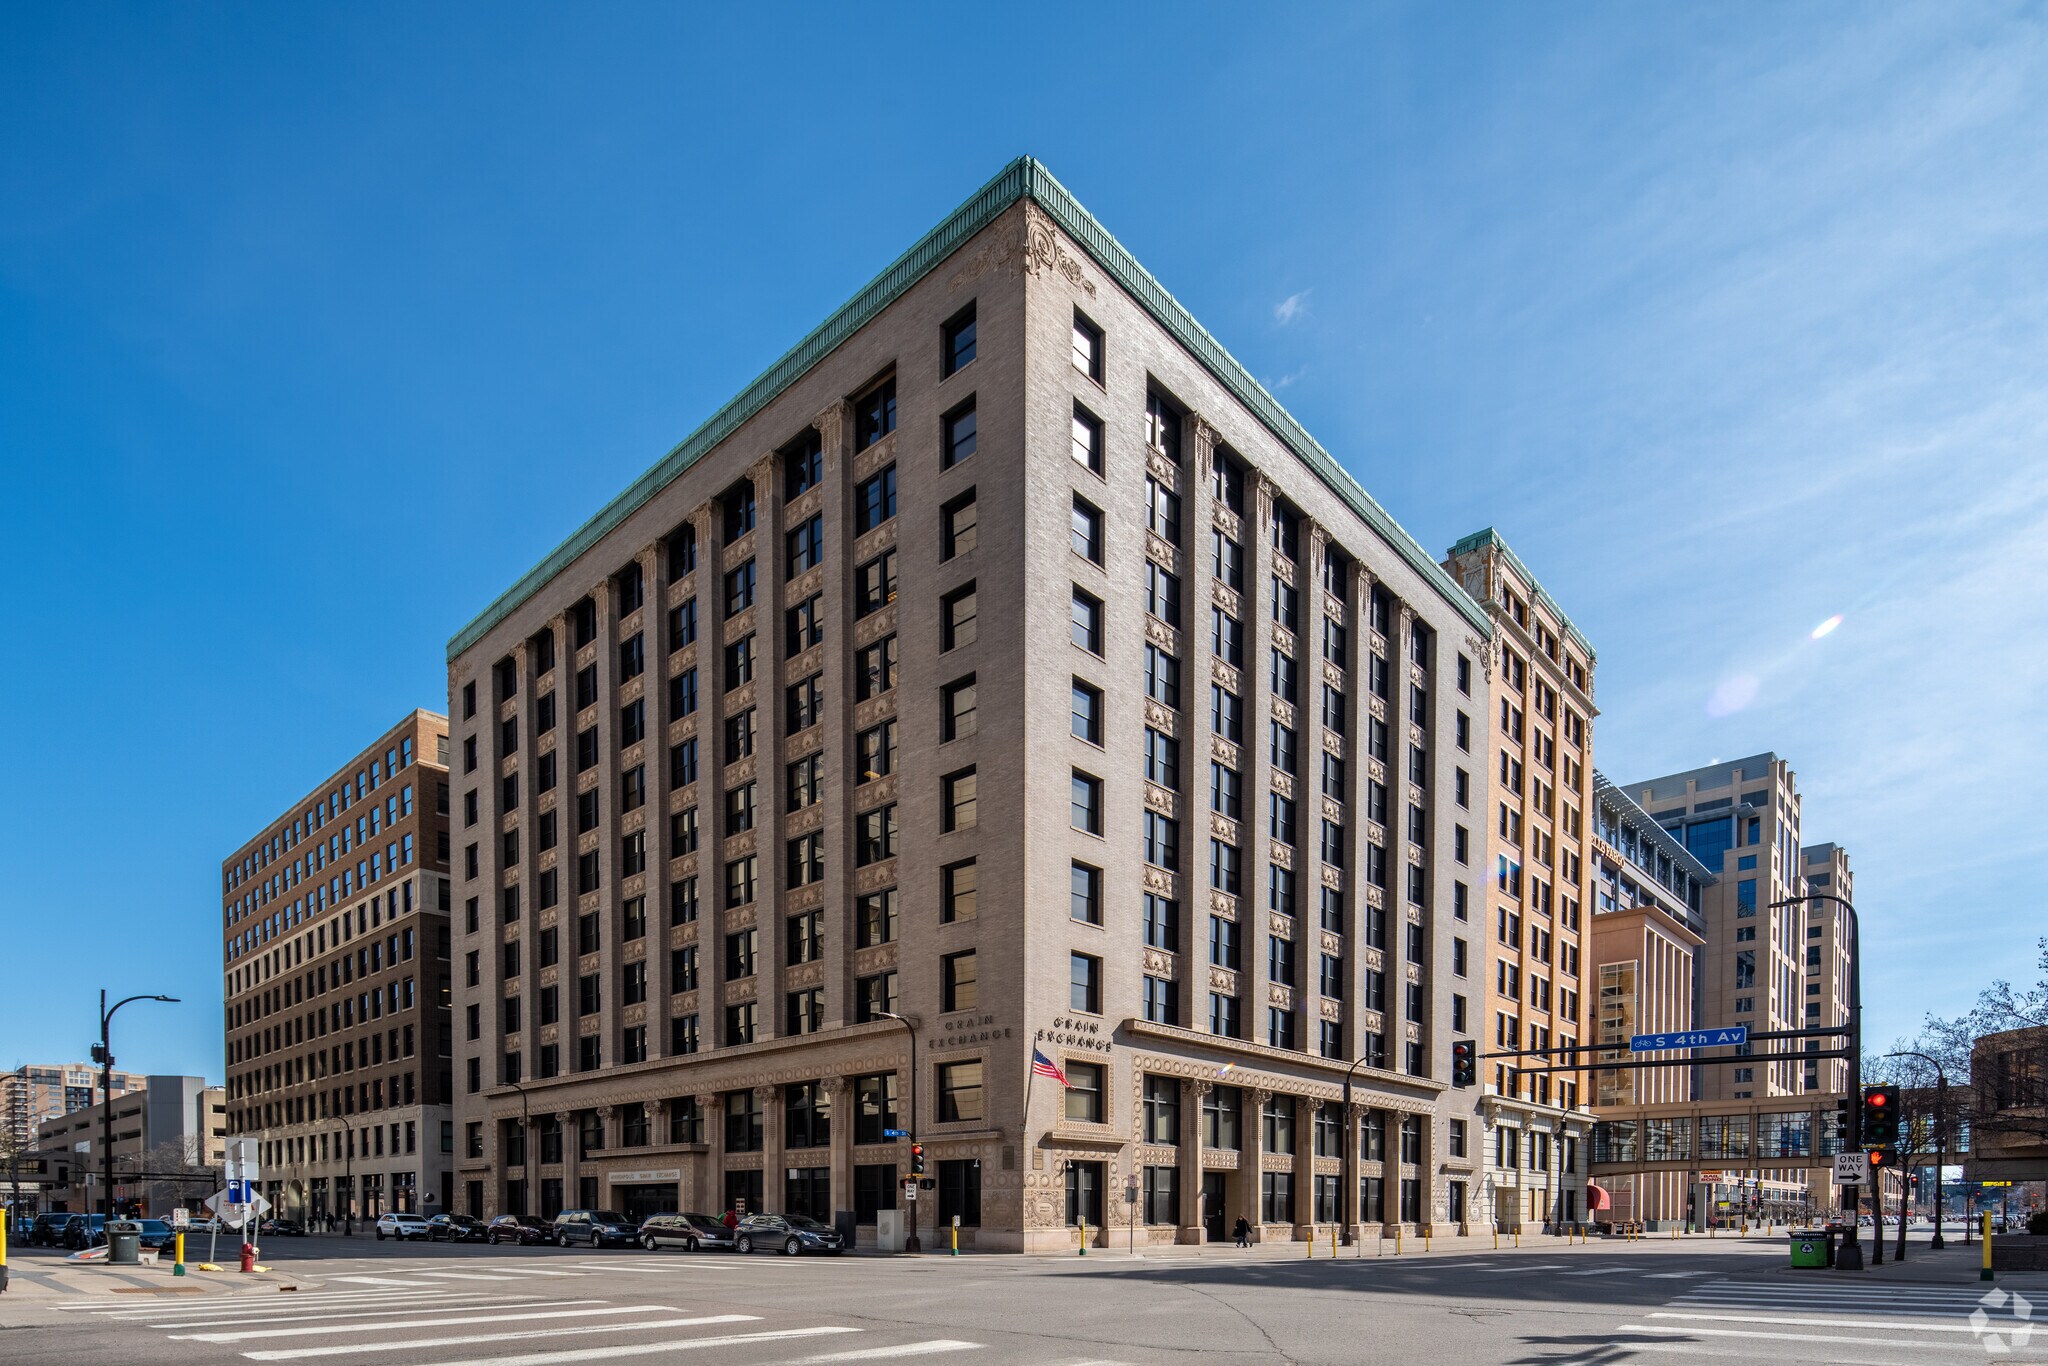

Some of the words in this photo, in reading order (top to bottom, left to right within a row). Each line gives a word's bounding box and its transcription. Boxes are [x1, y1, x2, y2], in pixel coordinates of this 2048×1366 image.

[945, 1015, 992, 1031] GRAIN
[1053, 1017, 1098, 1034] GRAIN
[929, 1028, 1010, 1049] EXCHANGE
[1037, 1029, 1111, 1052] EXCHANGE
[1656, 1037, 1666, 1047] S
[1675, 1034, 1707, 1045] 4th
[1717, 1032, 1741, 1042] Av
[1839, 1155, 1862, 1163] ONE
